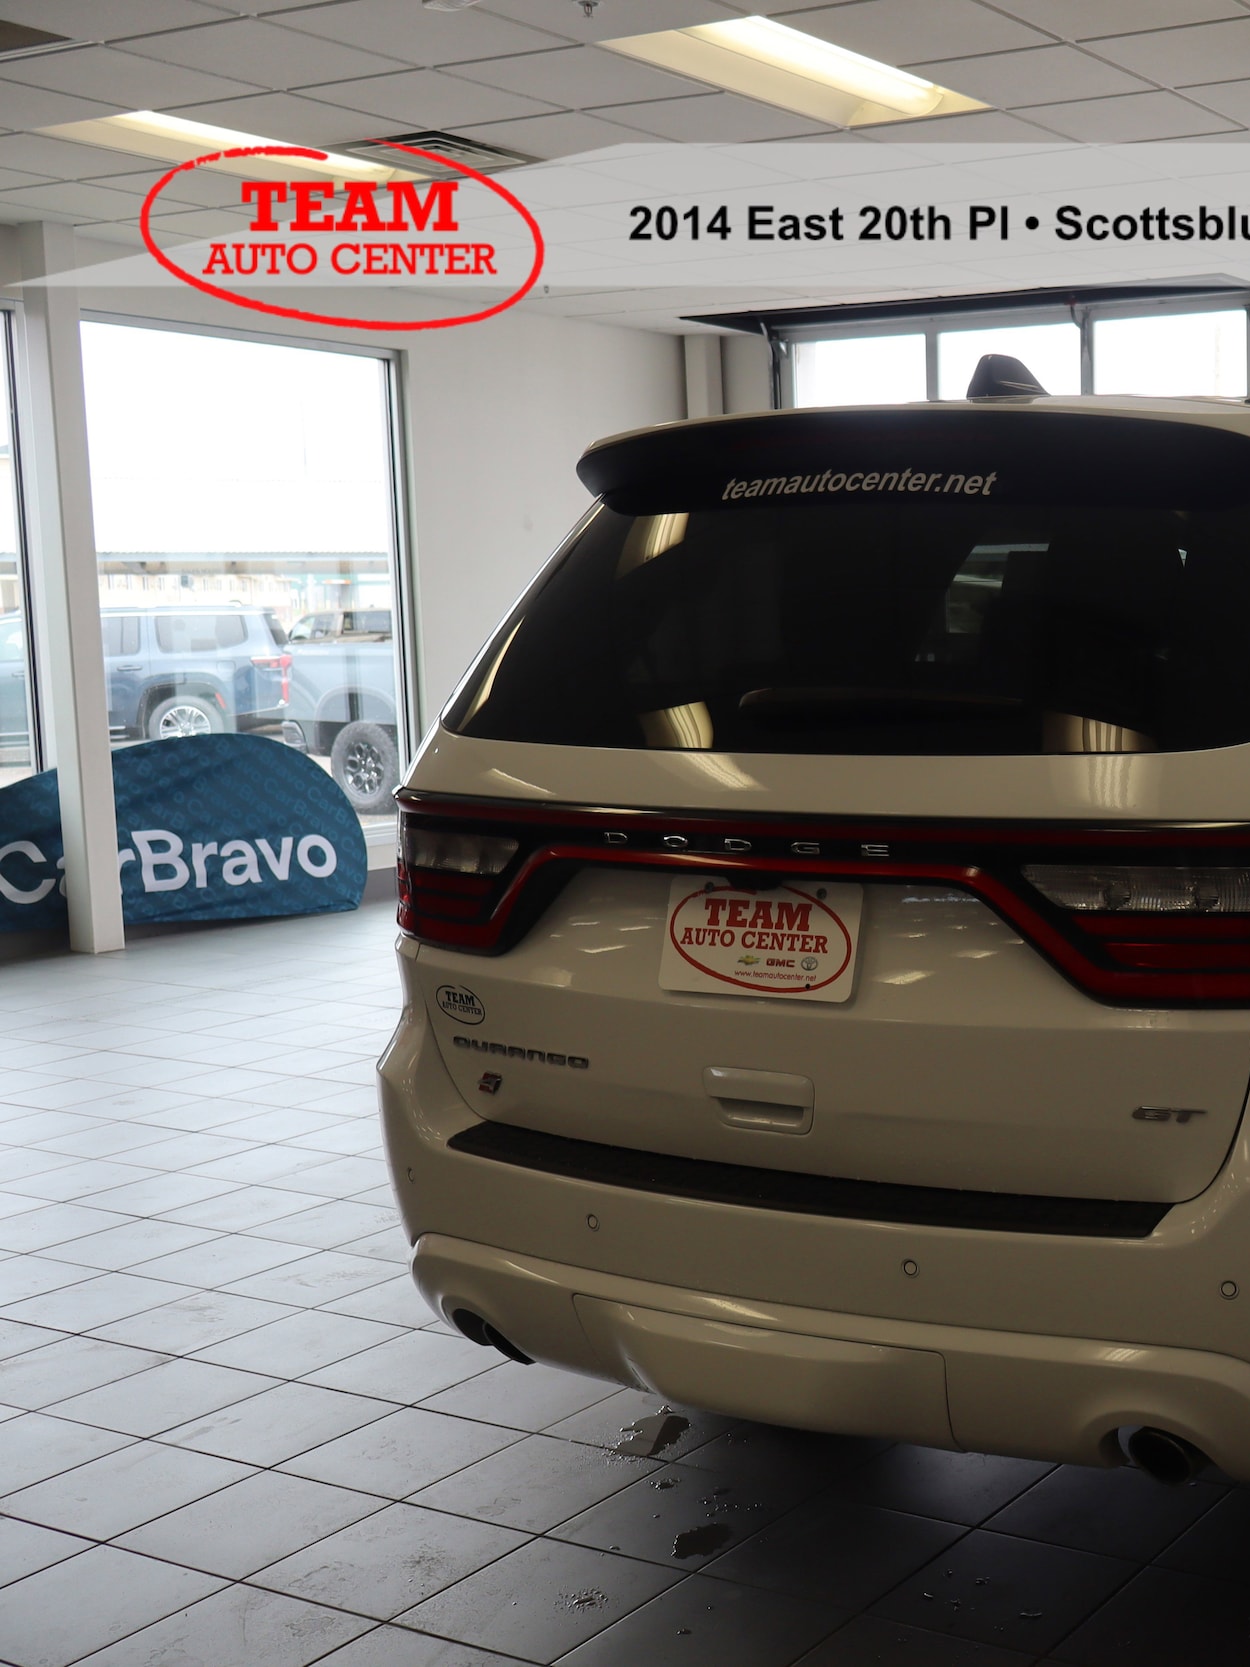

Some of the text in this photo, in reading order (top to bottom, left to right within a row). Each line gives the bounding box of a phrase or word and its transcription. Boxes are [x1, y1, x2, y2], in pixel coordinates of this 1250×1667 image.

[721, 467, 997, 500] teamautocenter.net
[604, 831, 890, 857] DODGE
[0, 829, 337, 905] CrBravo
[704, 898, 813, 932] TEAM
[680, 927, 828, 954] AUTO CENTER
[734, 970, 816, 982] www.teamautocenter.net
[766, 958, 795, 968] GMC
[442, 1000, 482, 1016] AUTO CENTER
[445, 990, 475, 1006] TEAM
[453, 1035, 589, 1069] DURANGO
[1132, 1106, 1207, 1124] GT
